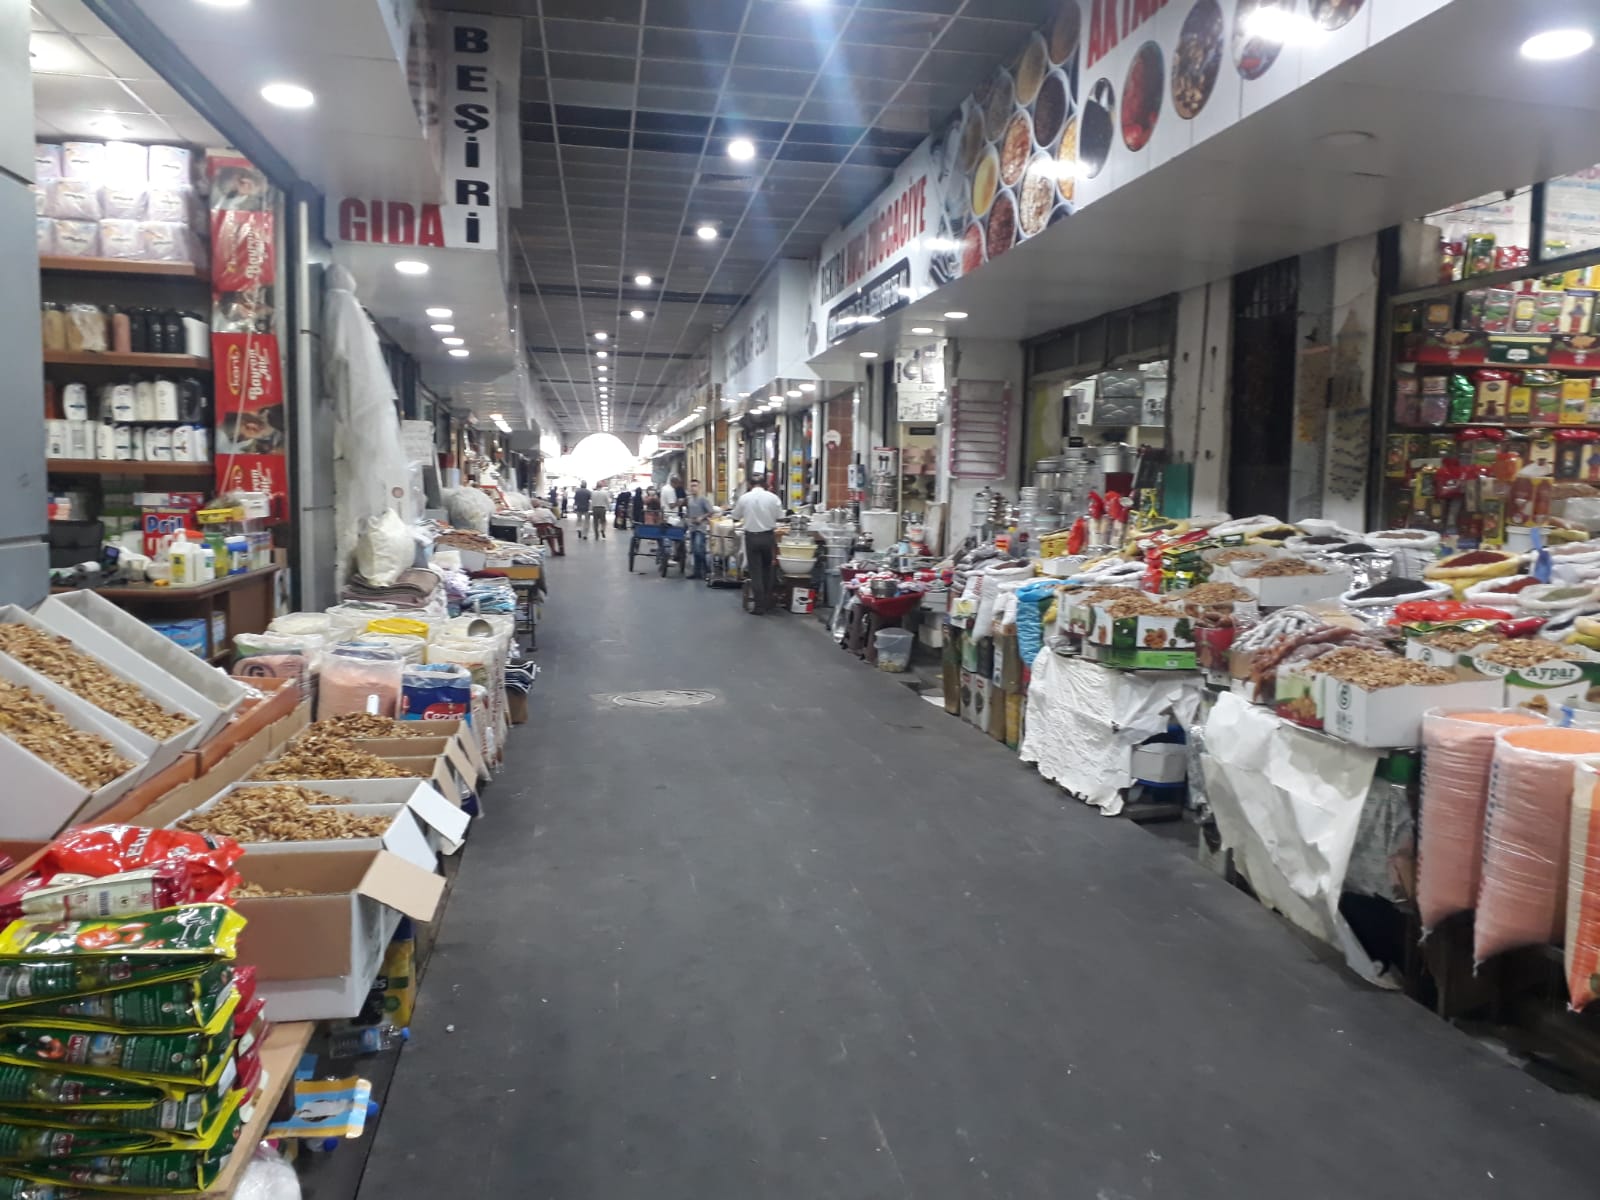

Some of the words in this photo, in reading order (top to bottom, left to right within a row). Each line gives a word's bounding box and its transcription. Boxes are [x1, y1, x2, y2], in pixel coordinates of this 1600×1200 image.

[454, 26, 490, 243] BEŞİRİ
[338, 197, 445, 248] GIDA
[146, 515, 184, 534] Pril
[1524, 667, 1577, 681] Aypar
